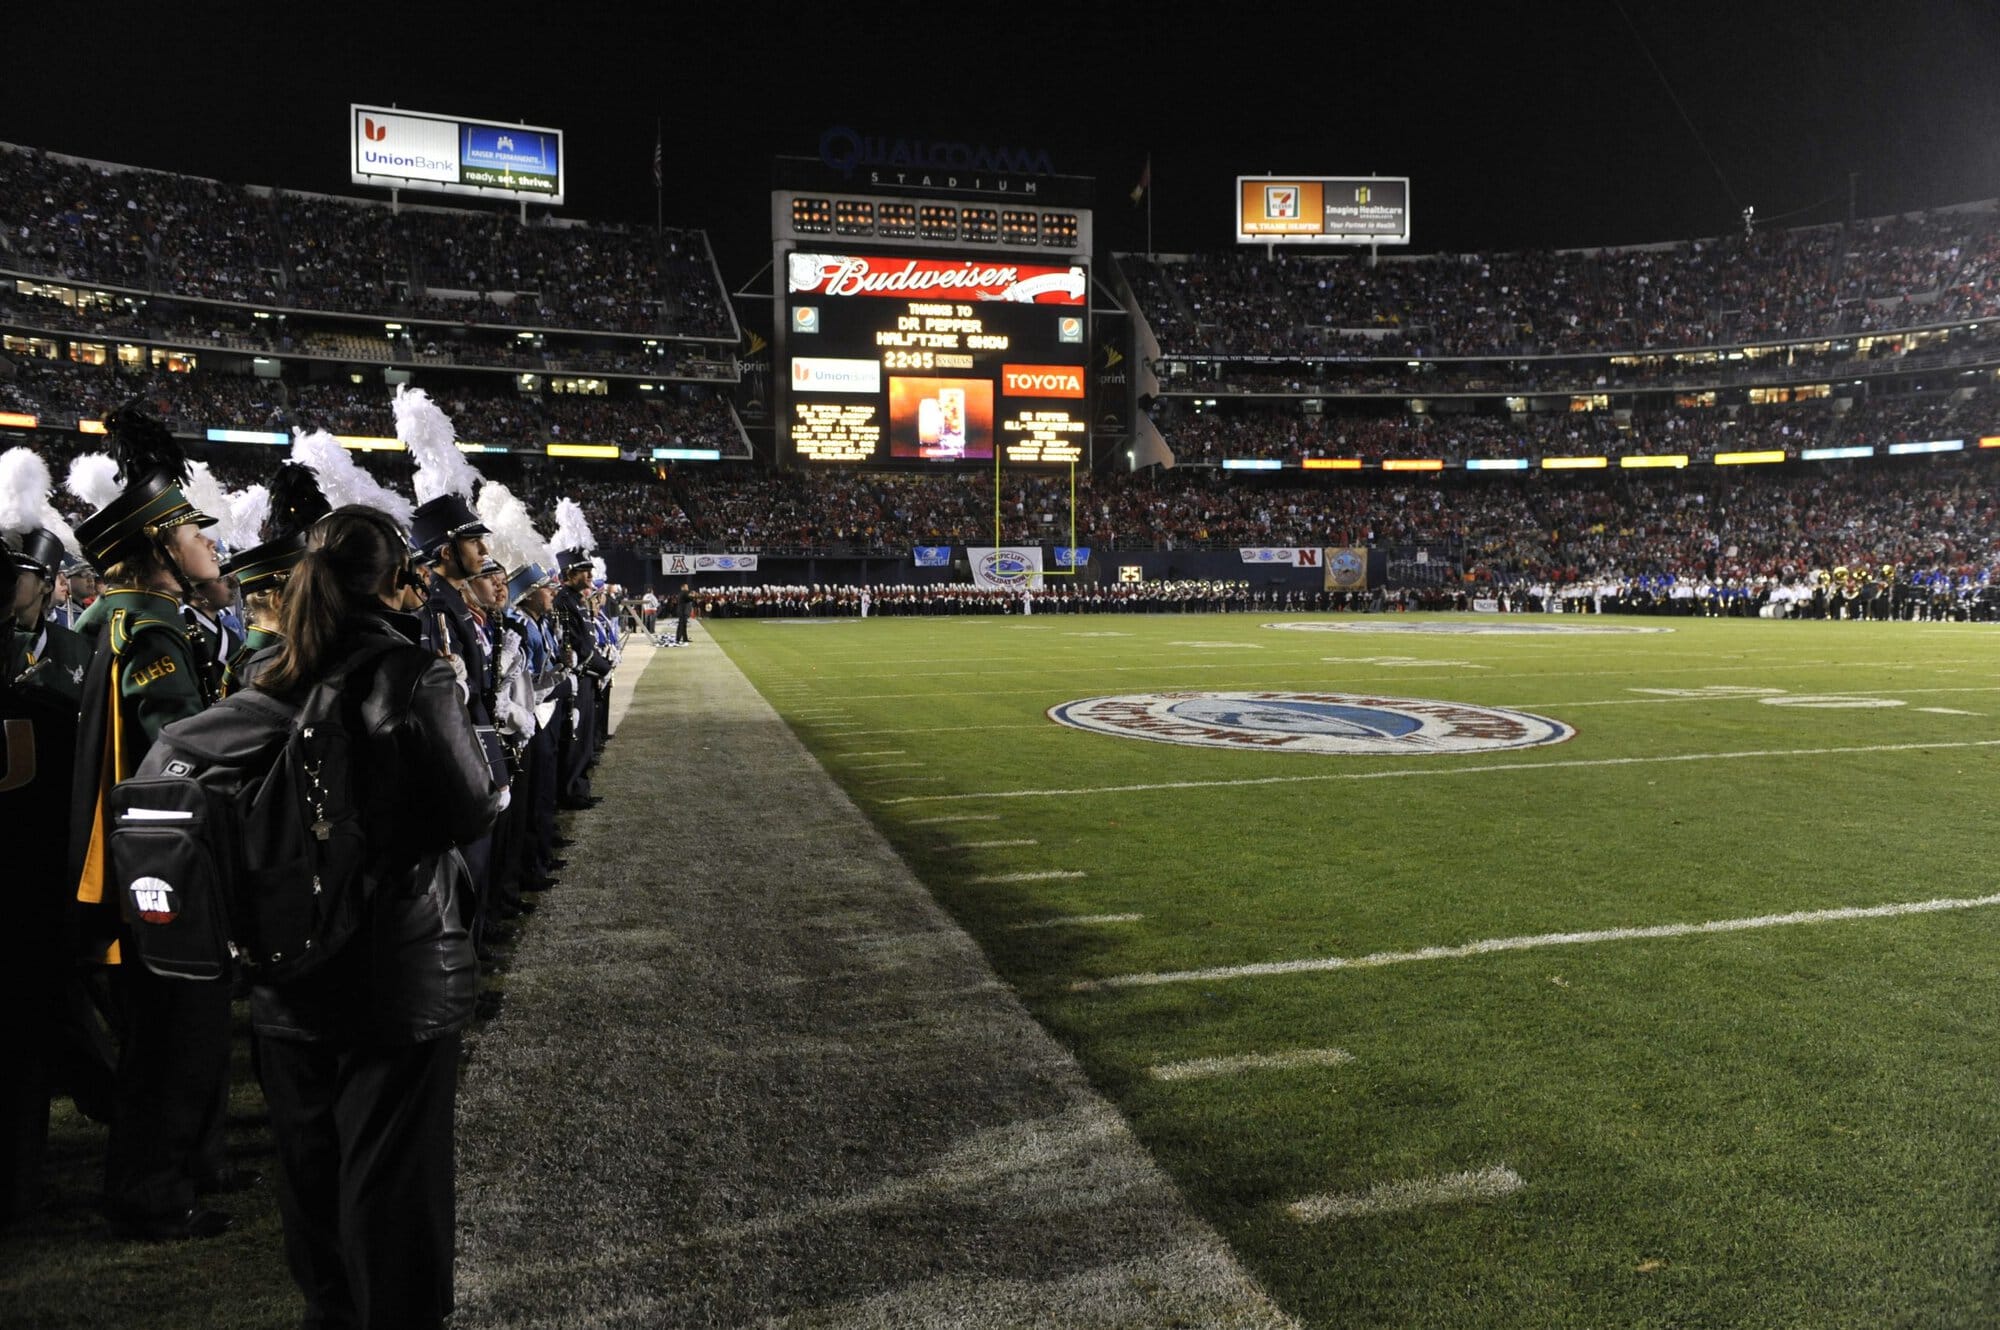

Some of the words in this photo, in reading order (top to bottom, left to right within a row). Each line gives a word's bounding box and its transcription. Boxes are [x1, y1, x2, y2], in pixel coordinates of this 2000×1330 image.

[819, 125, 1056, 179] QUALCOMM
[365, 151, 453, 171] UnionBank
[465, 171, 496, 184] ready.
[498, 175, 515, 185] set.
[518, 176, 553, 188] thrive.
[871, 172, 1037, 192] STADIUM
[1326, 205, 1358, 216] Imaging
[1359, 205, 1402, 215] Healthcare
[819, 260, 1017, 296] Budweiser
[908, 303, 953, 316] THANKS
[956, 305, 973, 317] TO
[898, 316, 920, 331] DR
[925, 318, 982, 333] PEPPER
[876, 331, 959, 348] HALFTIME
[966, 335, 1009, 349] SHOW
[737, 360, 770, 375] Sprint
[1007, 373, 1080, 391] TOYOTA
[670, 555, 689, 573] A
[1298, 549, 1316, 566] N
[1121, 567, 1140, 582] 25
